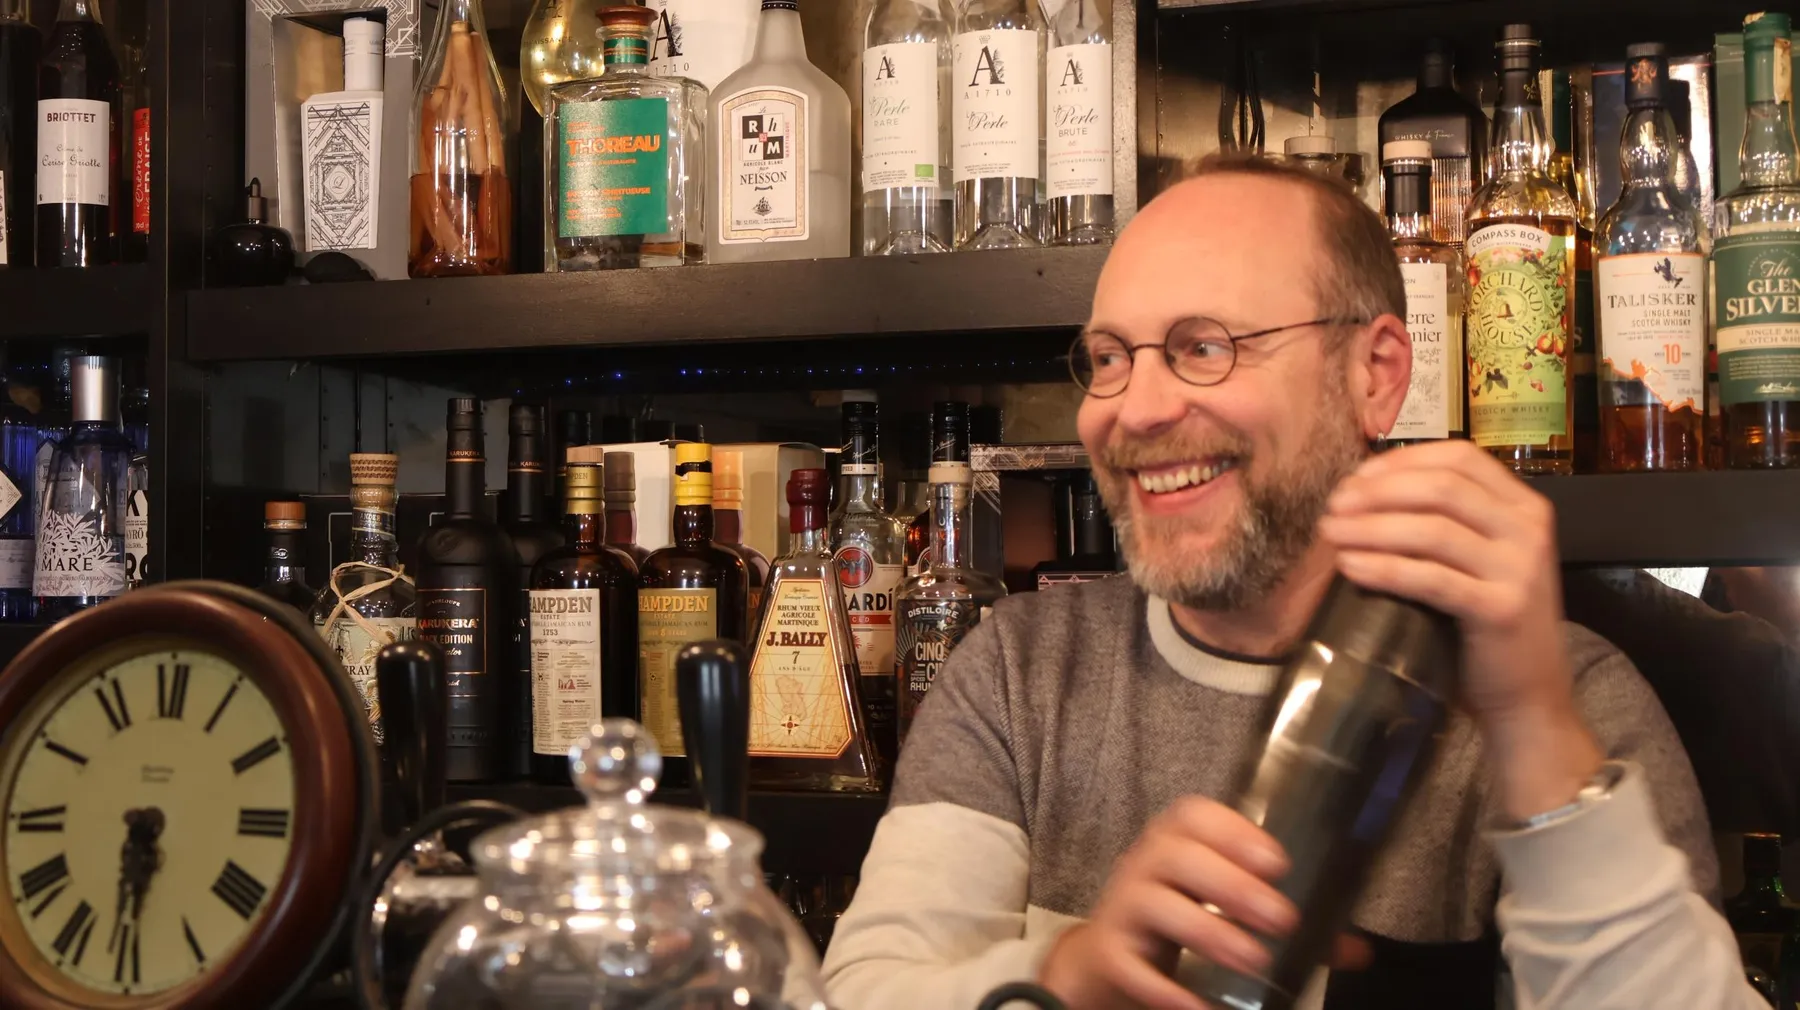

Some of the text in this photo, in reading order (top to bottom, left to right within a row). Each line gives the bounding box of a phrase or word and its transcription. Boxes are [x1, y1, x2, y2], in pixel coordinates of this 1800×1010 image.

[46, 111, 97, 124] BRIOTTET
[873, 117, 899, 128] RARE
[968, 110, 1009, 132] Perle
[1054, 103, 1099, 128] Perle
[1058, 126, 1088, 138] BRUTE
[566, 134, 661, 157] THOREAU
[739, 171, 788, 186] NEISSON
[1471, 228, 1517, 249] COMPASS
[1519, 228, 1543, 244] BOX
[1760, 259, 1794, 278] The
[1472, 271, 1545, 313] ORCHARD
[1607, 293, 1698, 309] TALISKER
[1643, 309, 1691, 318] SINGLE MALT
[1480, 311, 1538, 346] HOUSE
[1631, 318, 1692, 328] SCOTCH WHISKY
[1663, 343, 1682, 365] 10
[41, 557, 93, 572] MARE
[777, 604, 821, 612] RHUM VIEUX
[907, 606, 960, 619] DISTILOIRE
[417, 618, 477, 630] KARUKERA
[777, 619, 819, 627] MARTINIQUE
[440, 634, 473, 645] EDITION
[542, 628, 559, 636] 1753
[791, 650, 801, 665] 7
[915, 642, 947, 662] CINQ
